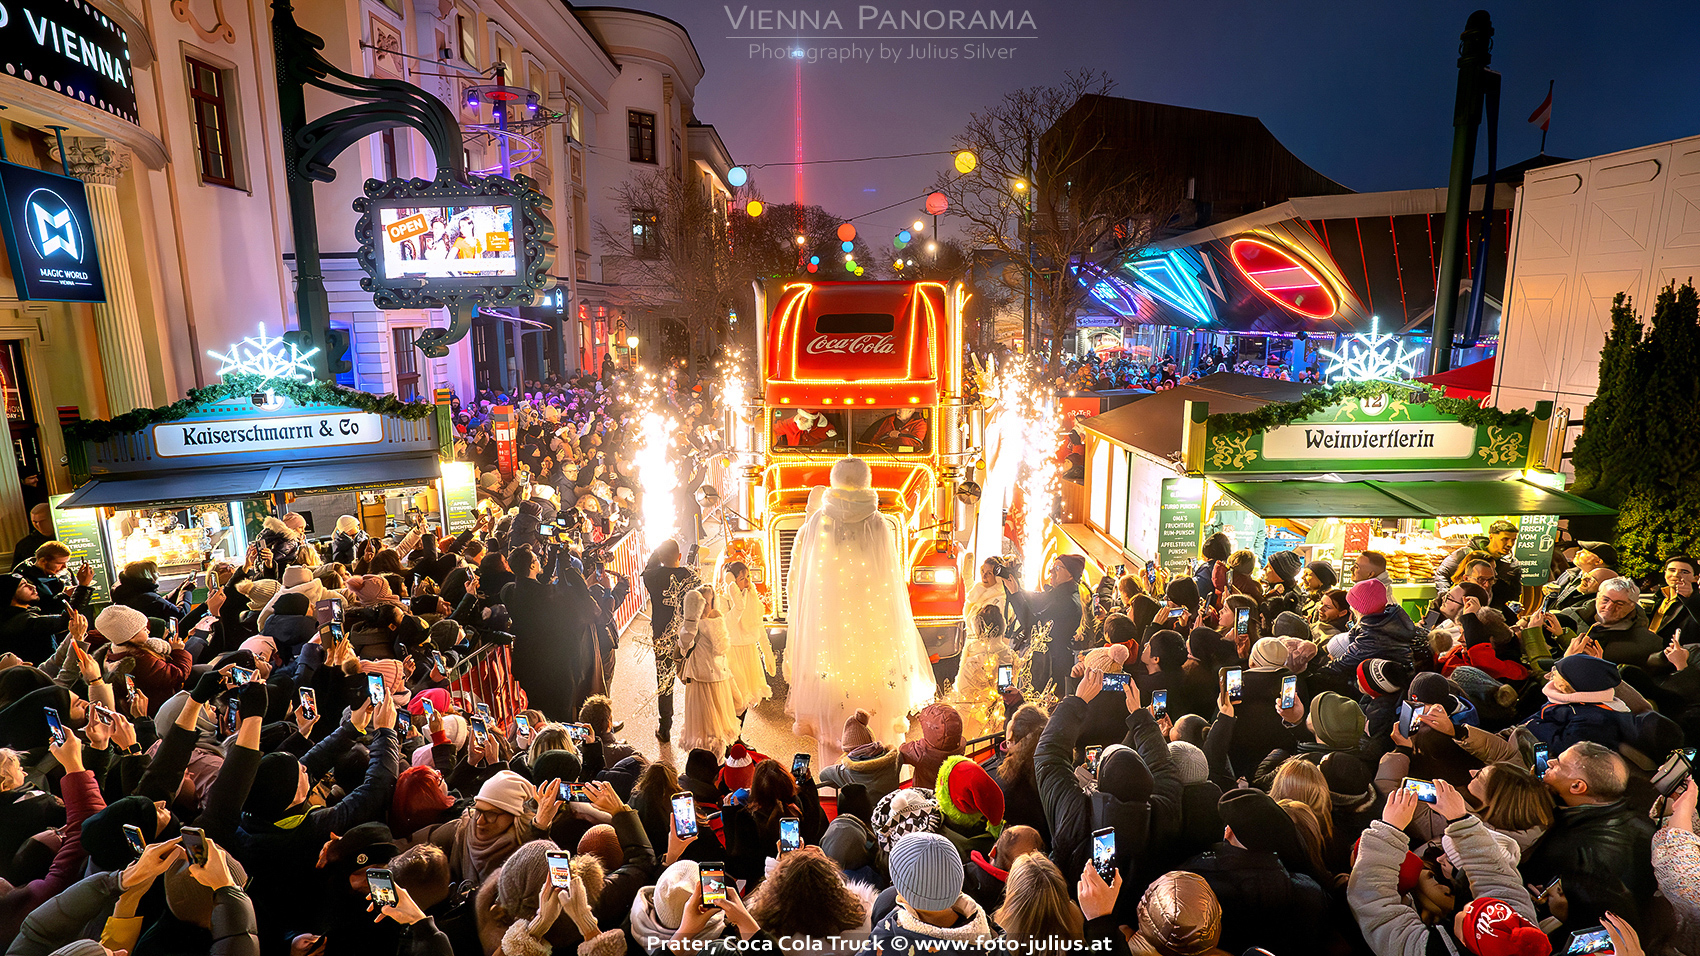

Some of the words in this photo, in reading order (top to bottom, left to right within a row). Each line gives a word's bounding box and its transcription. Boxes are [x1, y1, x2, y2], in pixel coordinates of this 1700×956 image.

[23, 8, 128, 89] VIENNA
[390, 218, 424, 238] OPEN
[40, 268, 64, 278] MAGIC
[64, 270, 88, 280] WORLD
[806, 334, 896, 354] Coca-Cola
[182, 424, 314, 446] Kaiserschmarrn
[319, 419, 334, 437] &
[339, 418, 359, 436] Co
[1305, 429, 1435, 449] Weinviertlerin
[1521, 515, 1547, 524] BIER
